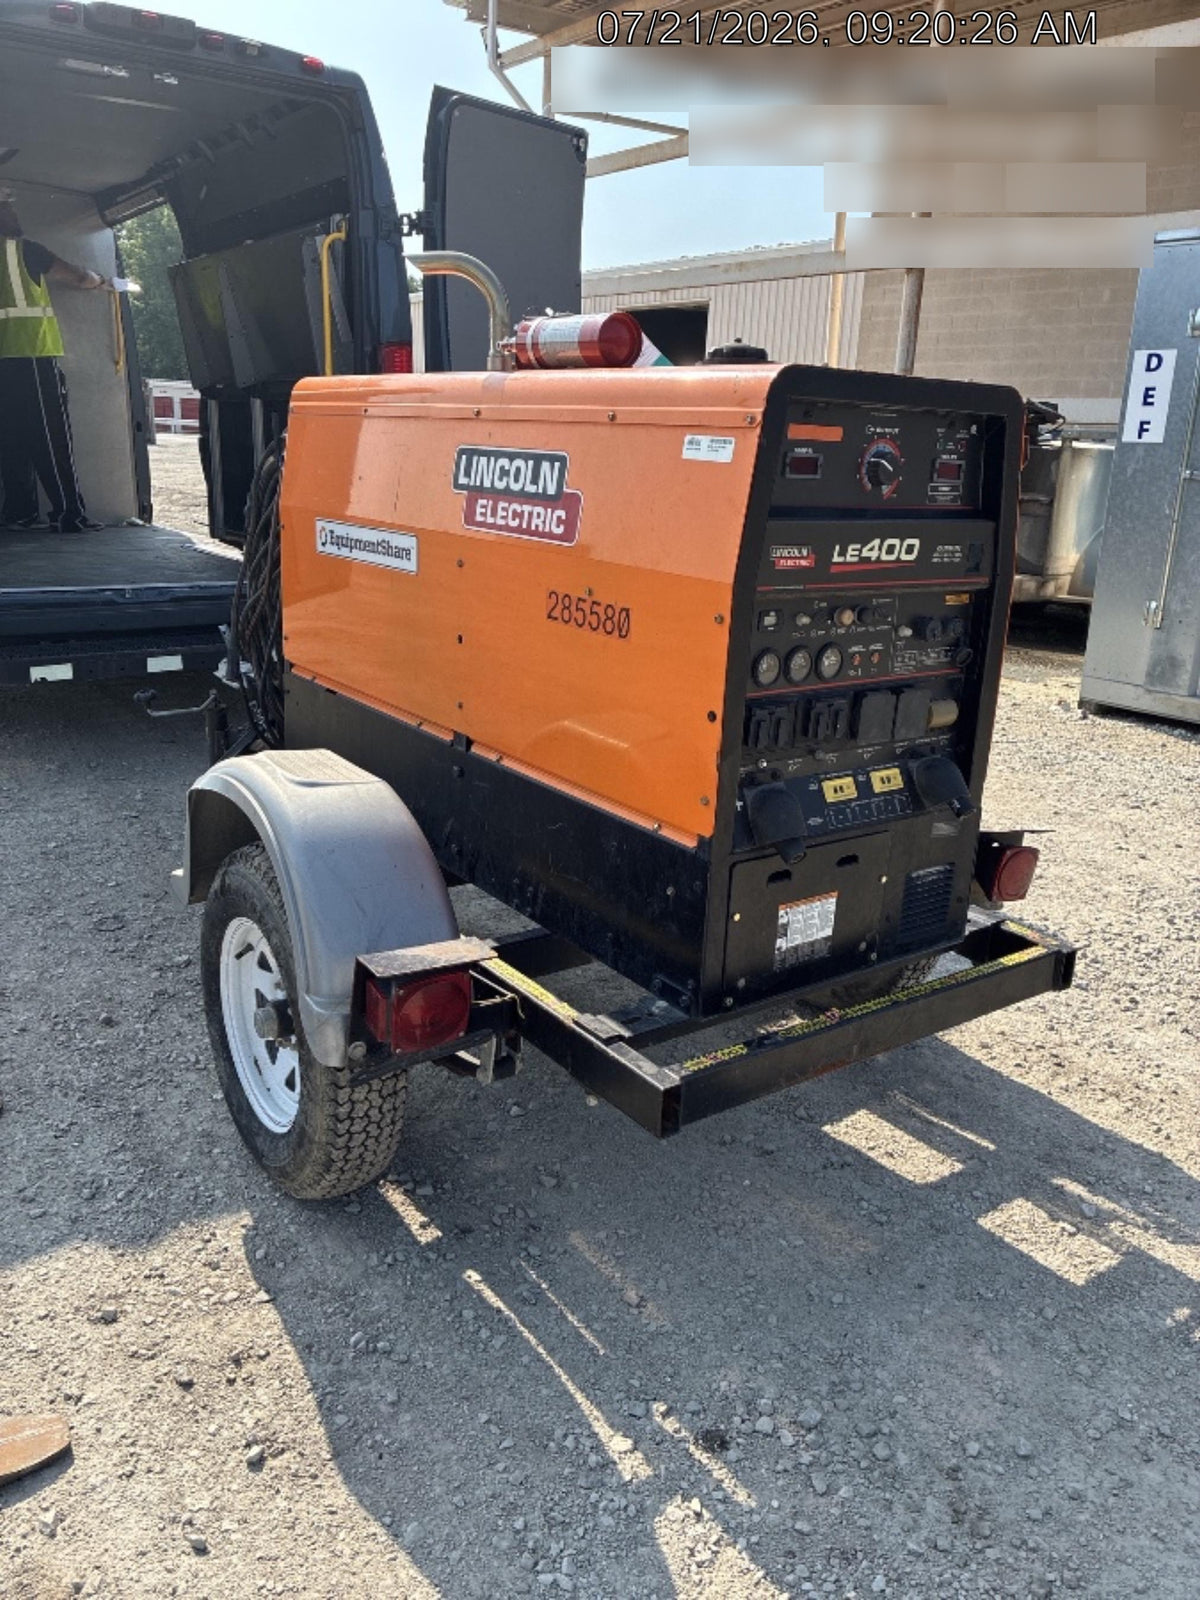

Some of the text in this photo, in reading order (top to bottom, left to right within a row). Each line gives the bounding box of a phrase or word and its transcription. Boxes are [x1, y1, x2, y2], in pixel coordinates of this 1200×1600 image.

[458, 455, 560, 495] LINCOLN
[475, 499, 566, 534] ELECTRIC
[328, 529, 411, 561] EquipmentShare
[831, 538, 920, 562] LE400
[547, 591, 630, 639] 285580
